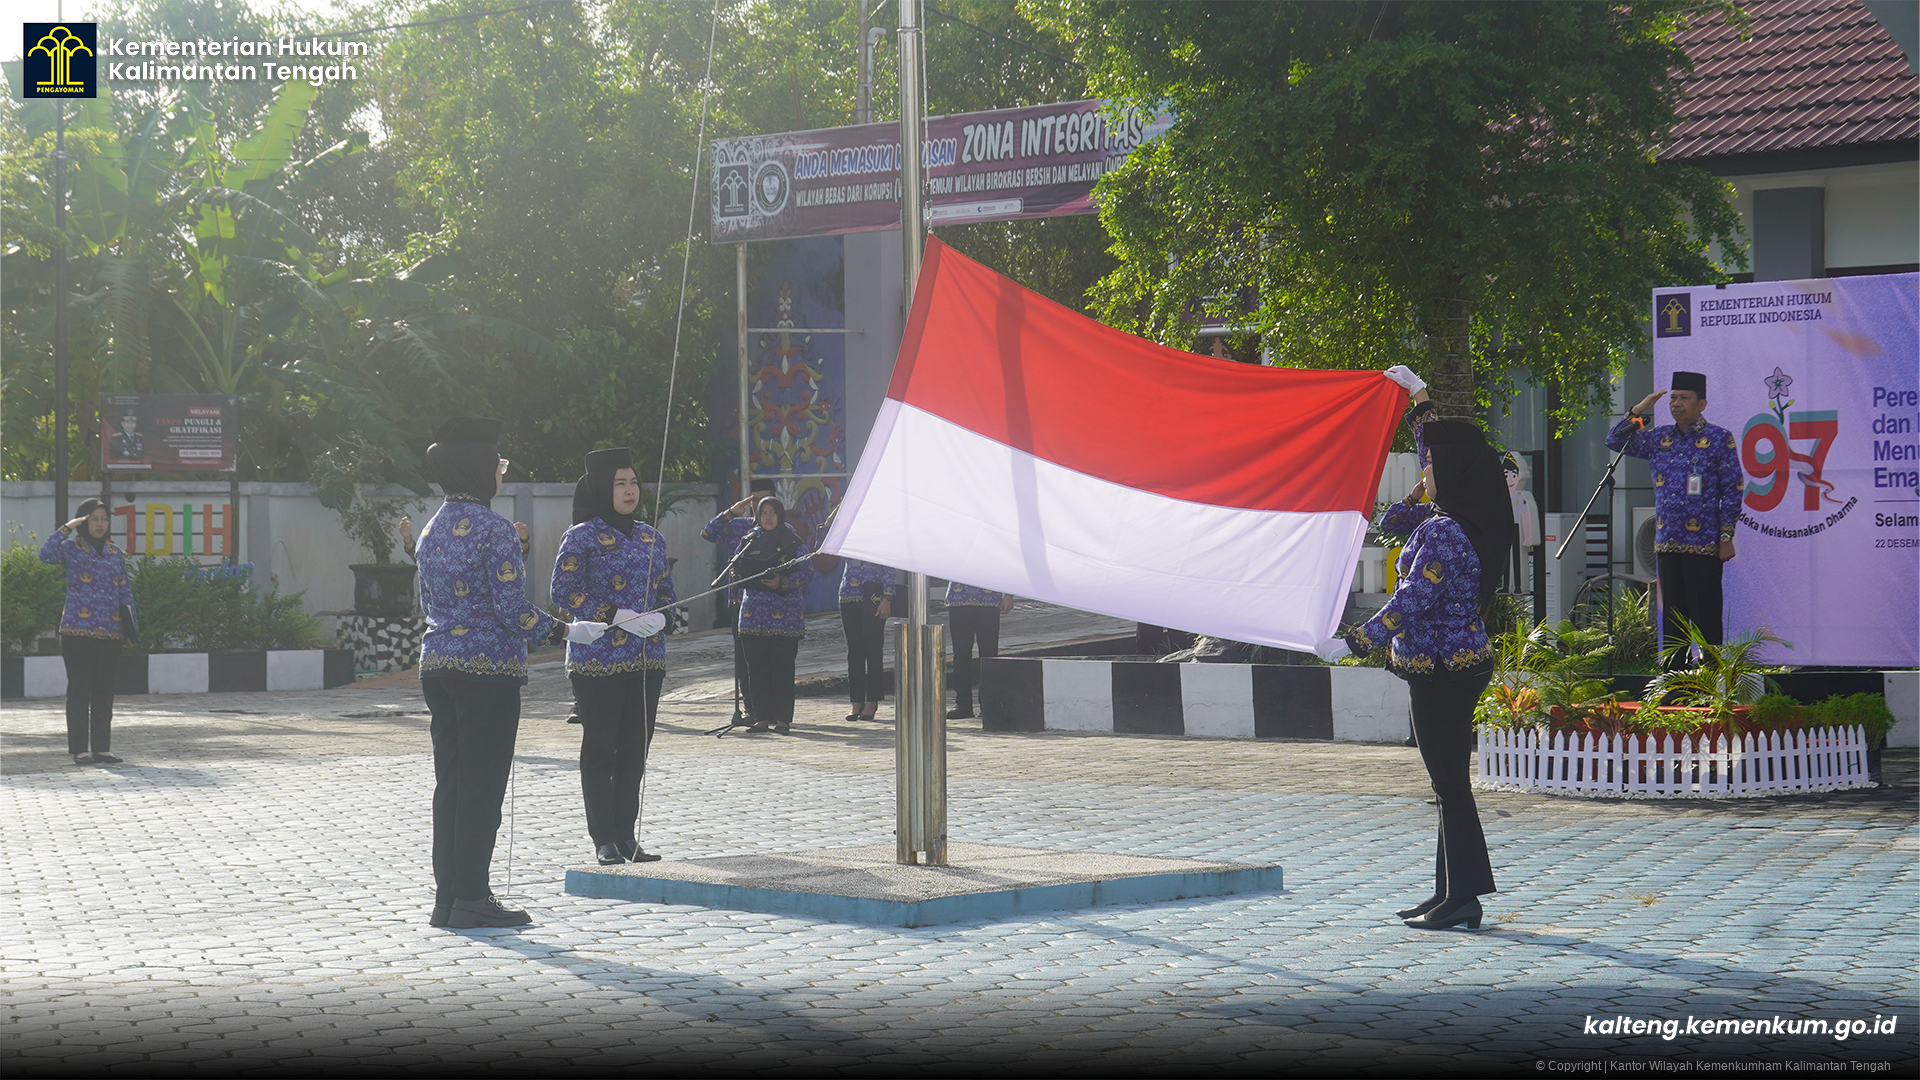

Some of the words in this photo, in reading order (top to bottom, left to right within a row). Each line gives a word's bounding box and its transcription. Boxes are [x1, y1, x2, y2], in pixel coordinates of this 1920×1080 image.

[961, 119, 1015, 164] ZONA
[1020, 105, 1144, 158] INTEGRITAS
[795, 151, 828, 180] ANDA
[830, 143, 895, 176] MEMASUKI
[796, 187, 824, 207] WILAYAH
[825, 185, 846, 204] BEBAS
[847, 184, 863, 202] DARI
[864, 182, 893, 201] KORUPSI
[955, 172, 985, 193] WILAYAH
[986, 169, 1024, 190] BIROKRASI
[1025, 166, 1051, 186] BERSIH
[1052, 164, 1067, 184] DAN
[1068, 161, 1103, 182] MELAYANI
[1700, 295, 1784, 312] KEMENTERIAN
[1786, 292, 1833, 306] HUKUM
[1700, 312, 1757, 327] REPUBLIK
[1758, 309, 1823, 324] INDONESIA
[1873, 386, 1919, 408] Pere
[169, 426, 222, 434] GRATIFIKASI
[184, 418, 214, 426] PUNGLI
[215, 418, 222, 426] &
[1872, 413, 1911, 434] dan
[1741, 410, 1839, 512] 97
[1873, 440, 1920, 461] Men
[1760, 522, 1826, 539] Melaksanakan
[1825, 496, 1858, 528] Dharma
[1875, 512, 1919, 527] Selam
[1875, 539, 1886, 548] 22
